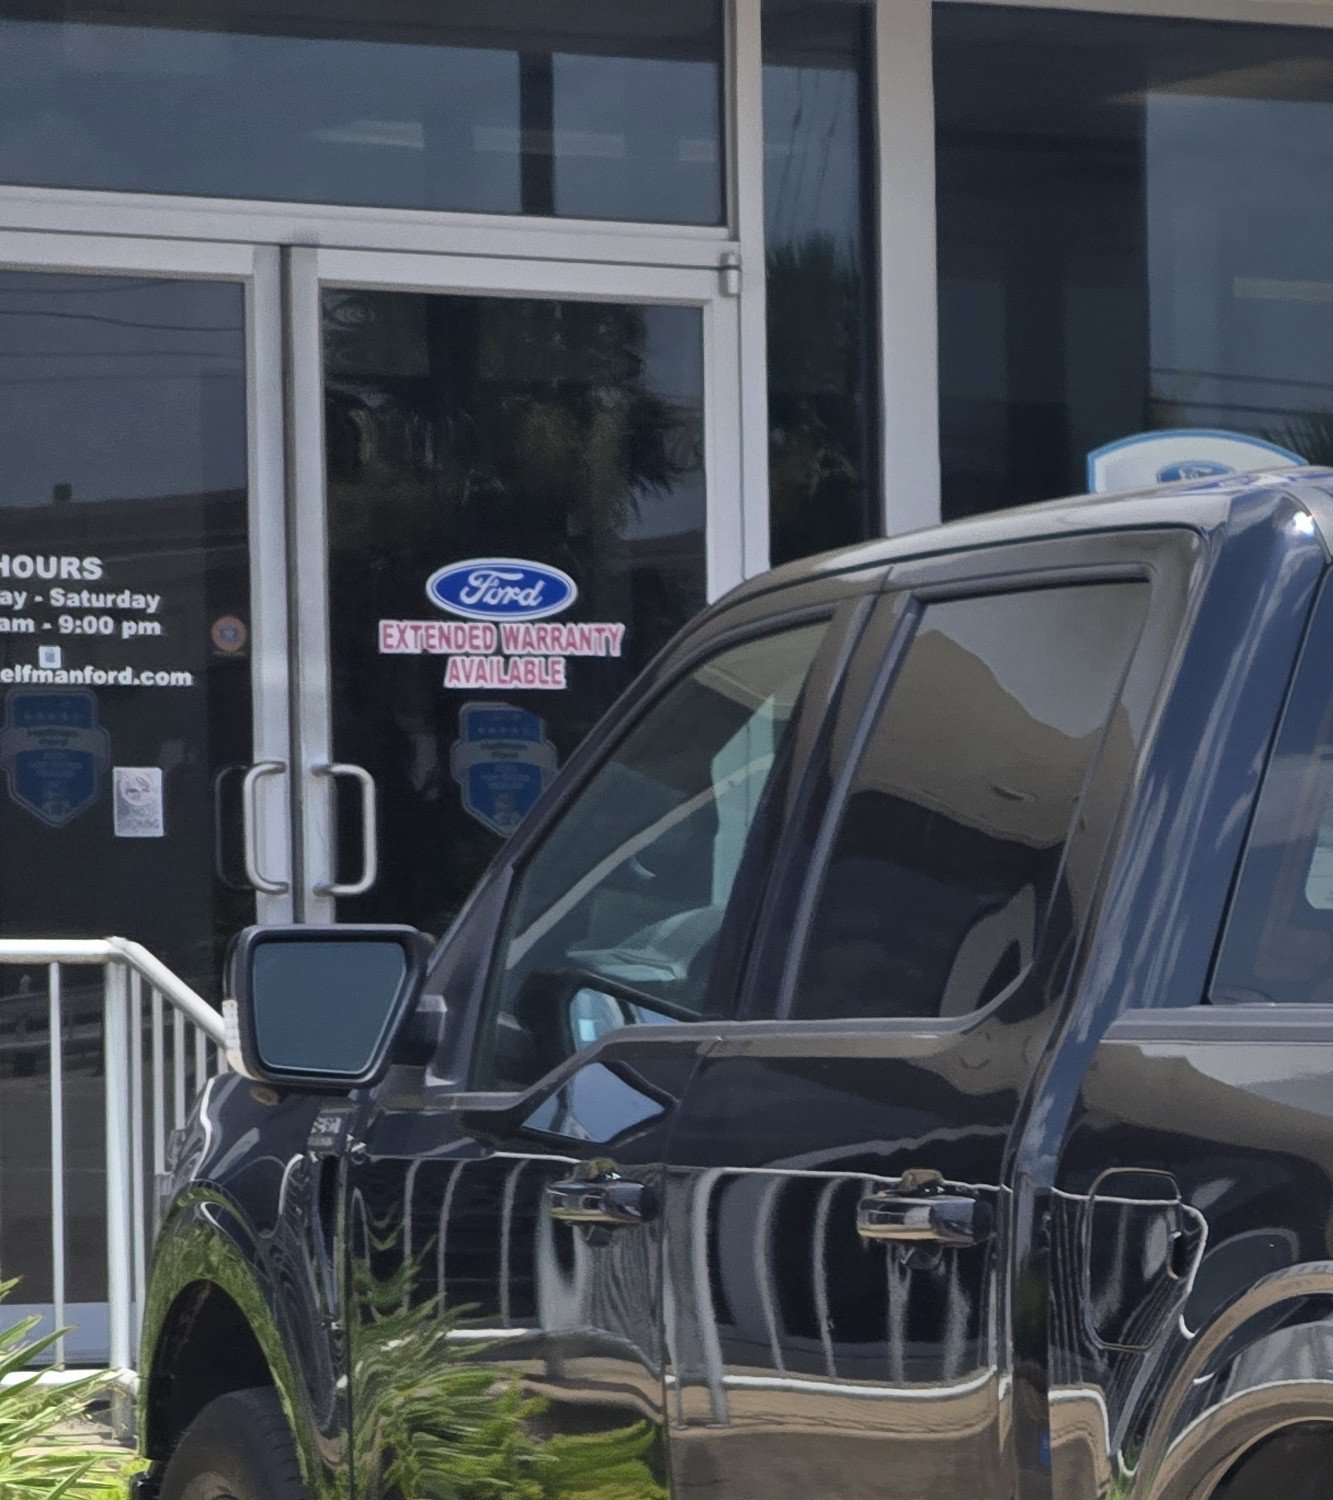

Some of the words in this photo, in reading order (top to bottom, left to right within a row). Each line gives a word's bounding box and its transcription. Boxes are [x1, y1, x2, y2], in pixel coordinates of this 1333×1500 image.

[50, 588, 161, 613] Saturday
[459, 570, 546, 606] Ford
[58, 615, 114, 634] 9:00
[121, 620, 161, 639] pm
[382, 622, 496, 651] EXTENDED
[502, 623, 622, 652] WARRANTY
[448, 658, 565, 685] AVAILABLE
